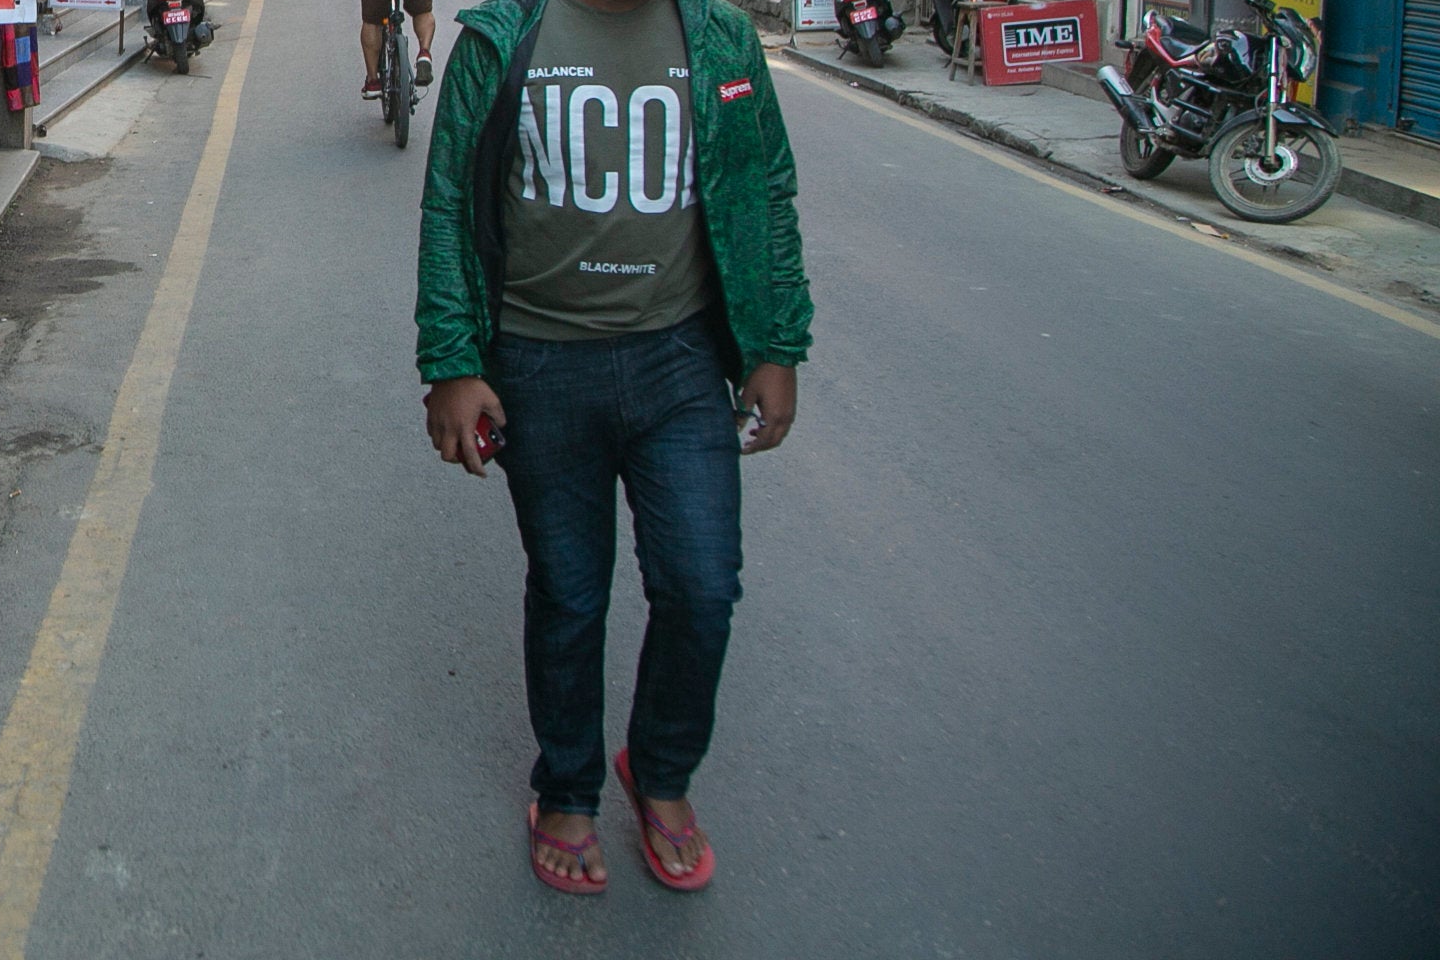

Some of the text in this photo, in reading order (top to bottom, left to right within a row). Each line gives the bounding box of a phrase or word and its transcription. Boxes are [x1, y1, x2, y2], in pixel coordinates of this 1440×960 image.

[1015, 24, 1074, 48] IME
[1011, 47, 1074, 59] International Money Express
[527, 66, 594, 79] BALANCEN
[579, 261, 656, 275] BLACK-WHITE
